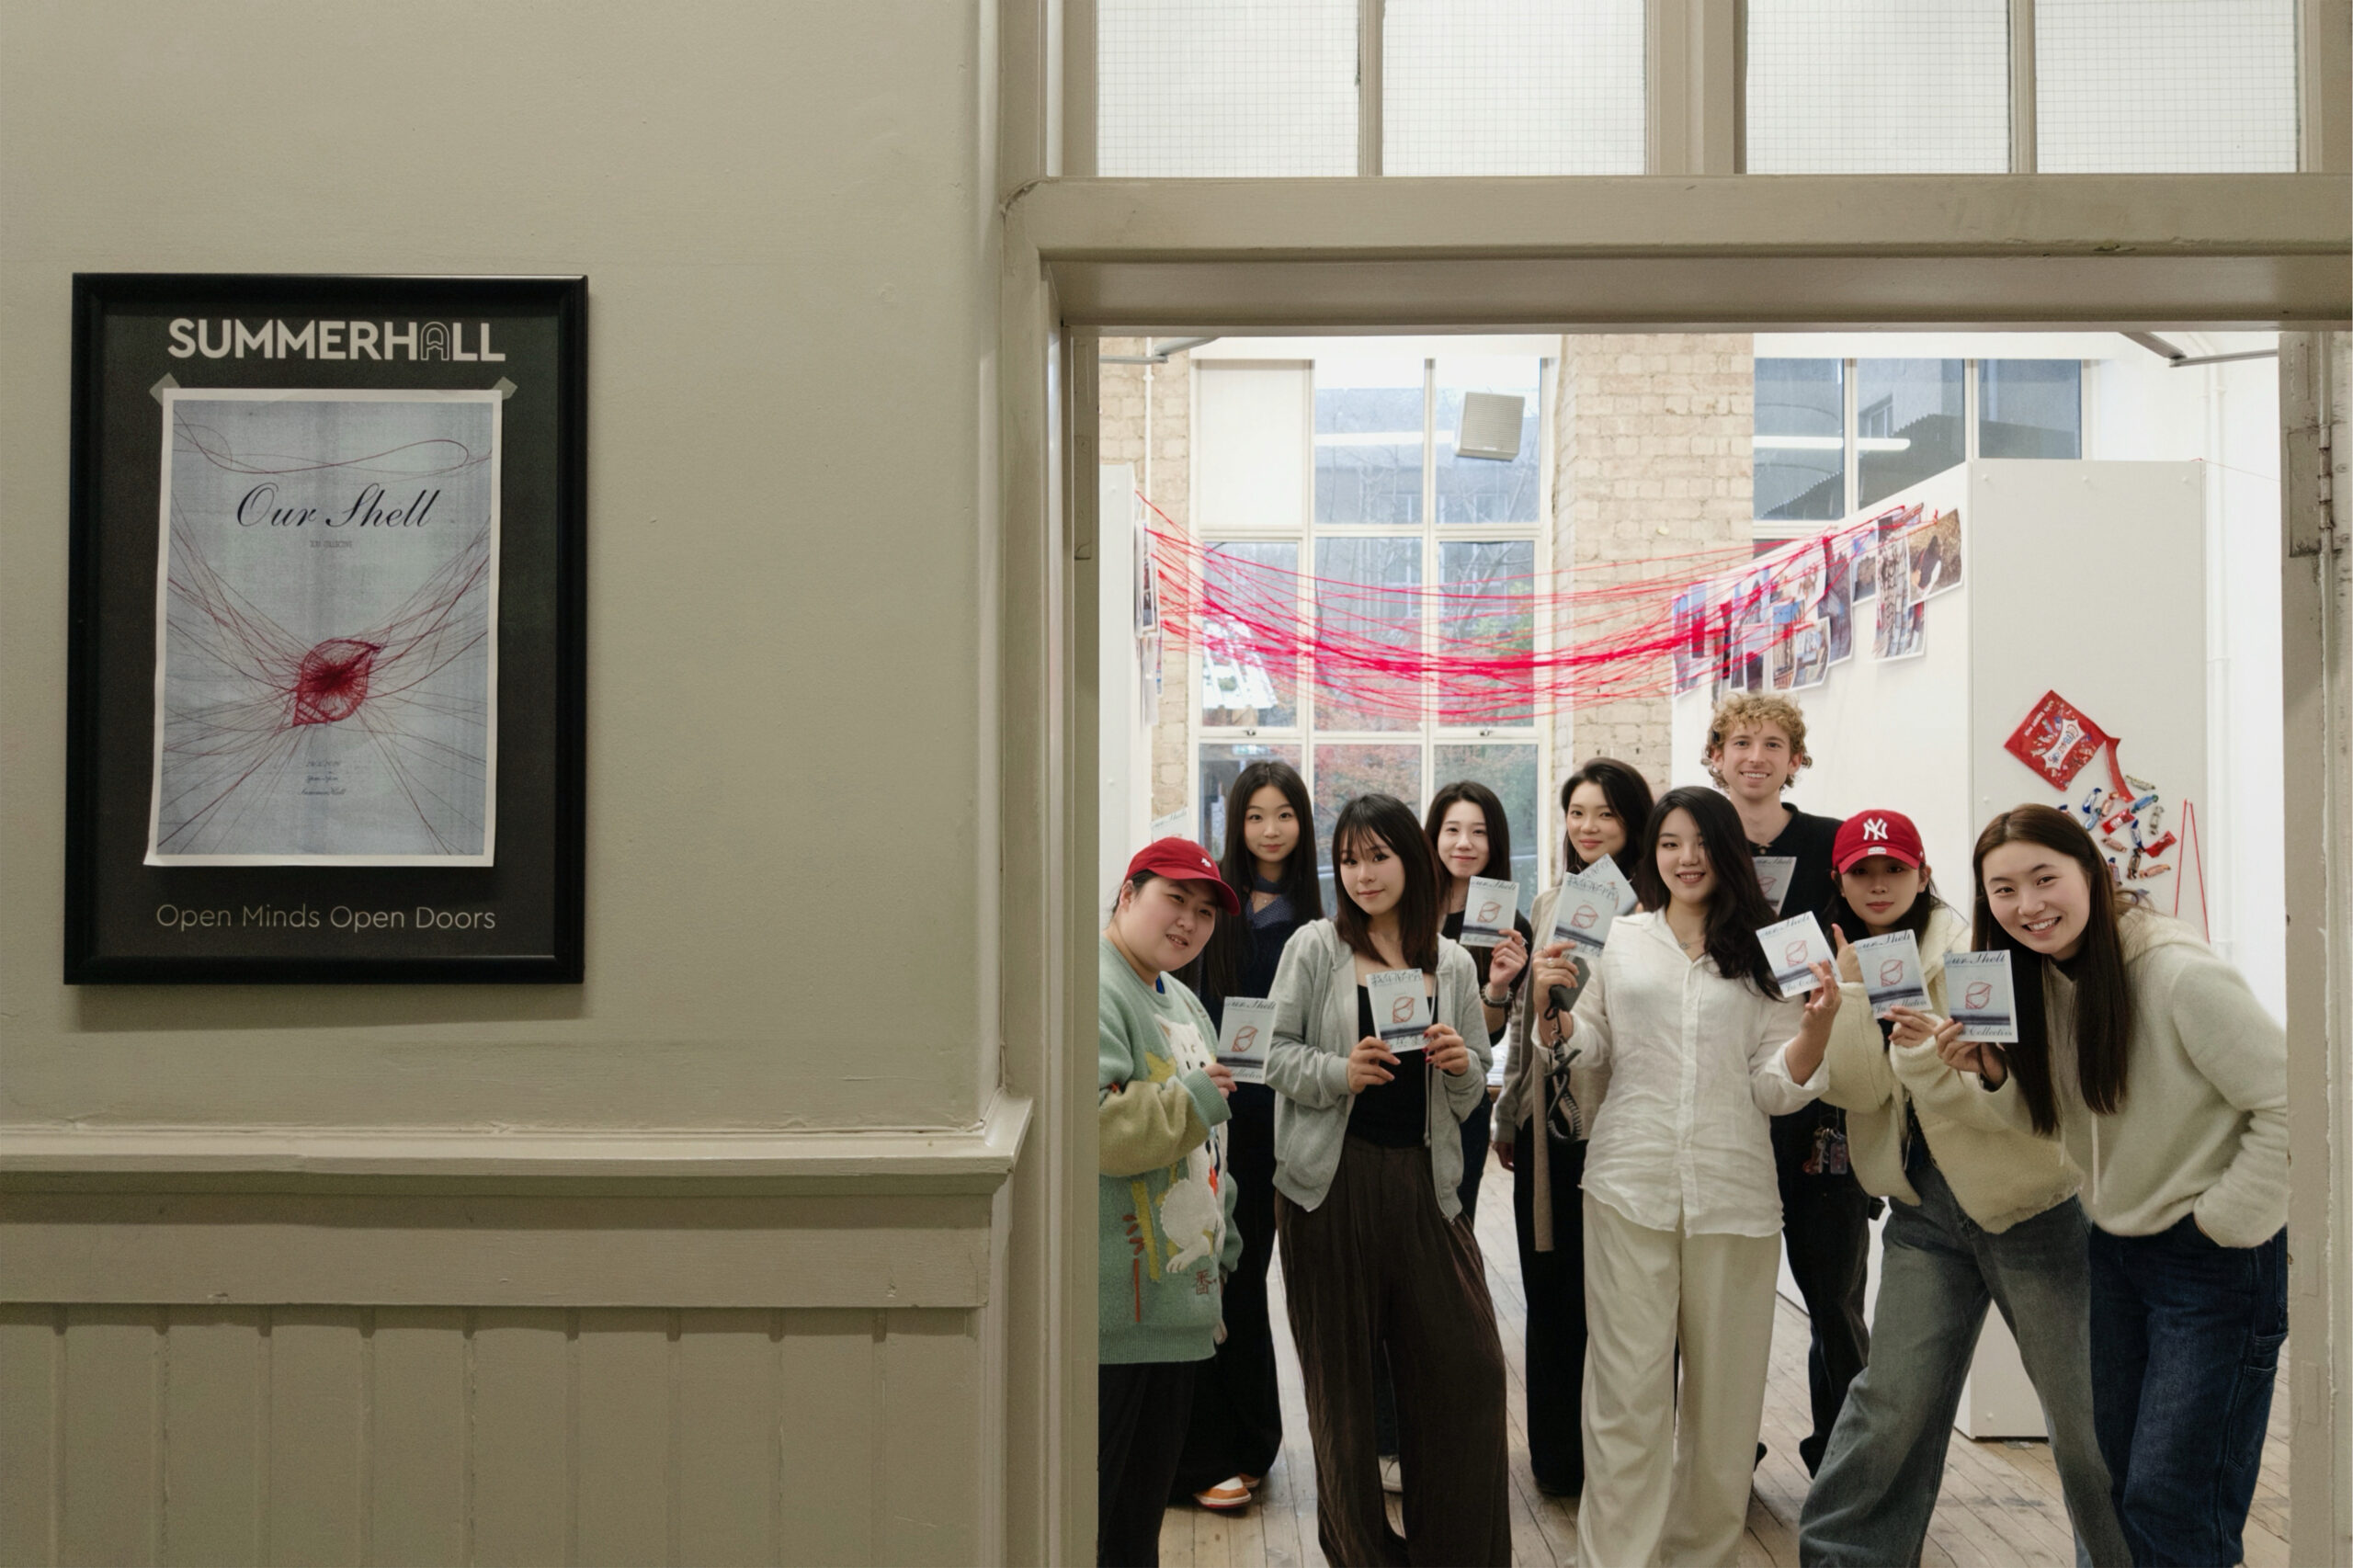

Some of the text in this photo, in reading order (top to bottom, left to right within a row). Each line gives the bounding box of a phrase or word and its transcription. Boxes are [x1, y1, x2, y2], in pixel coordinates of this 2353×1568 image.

[168, 318, 506, 361] SUMMERHALL
[236, 483, 441, 528] Our Shell
[1863, 817, 1889, 841] NY
[156, 903, 496, 933] Open Minds Open Doors
[1970, 951, 2006, 964] Shell
